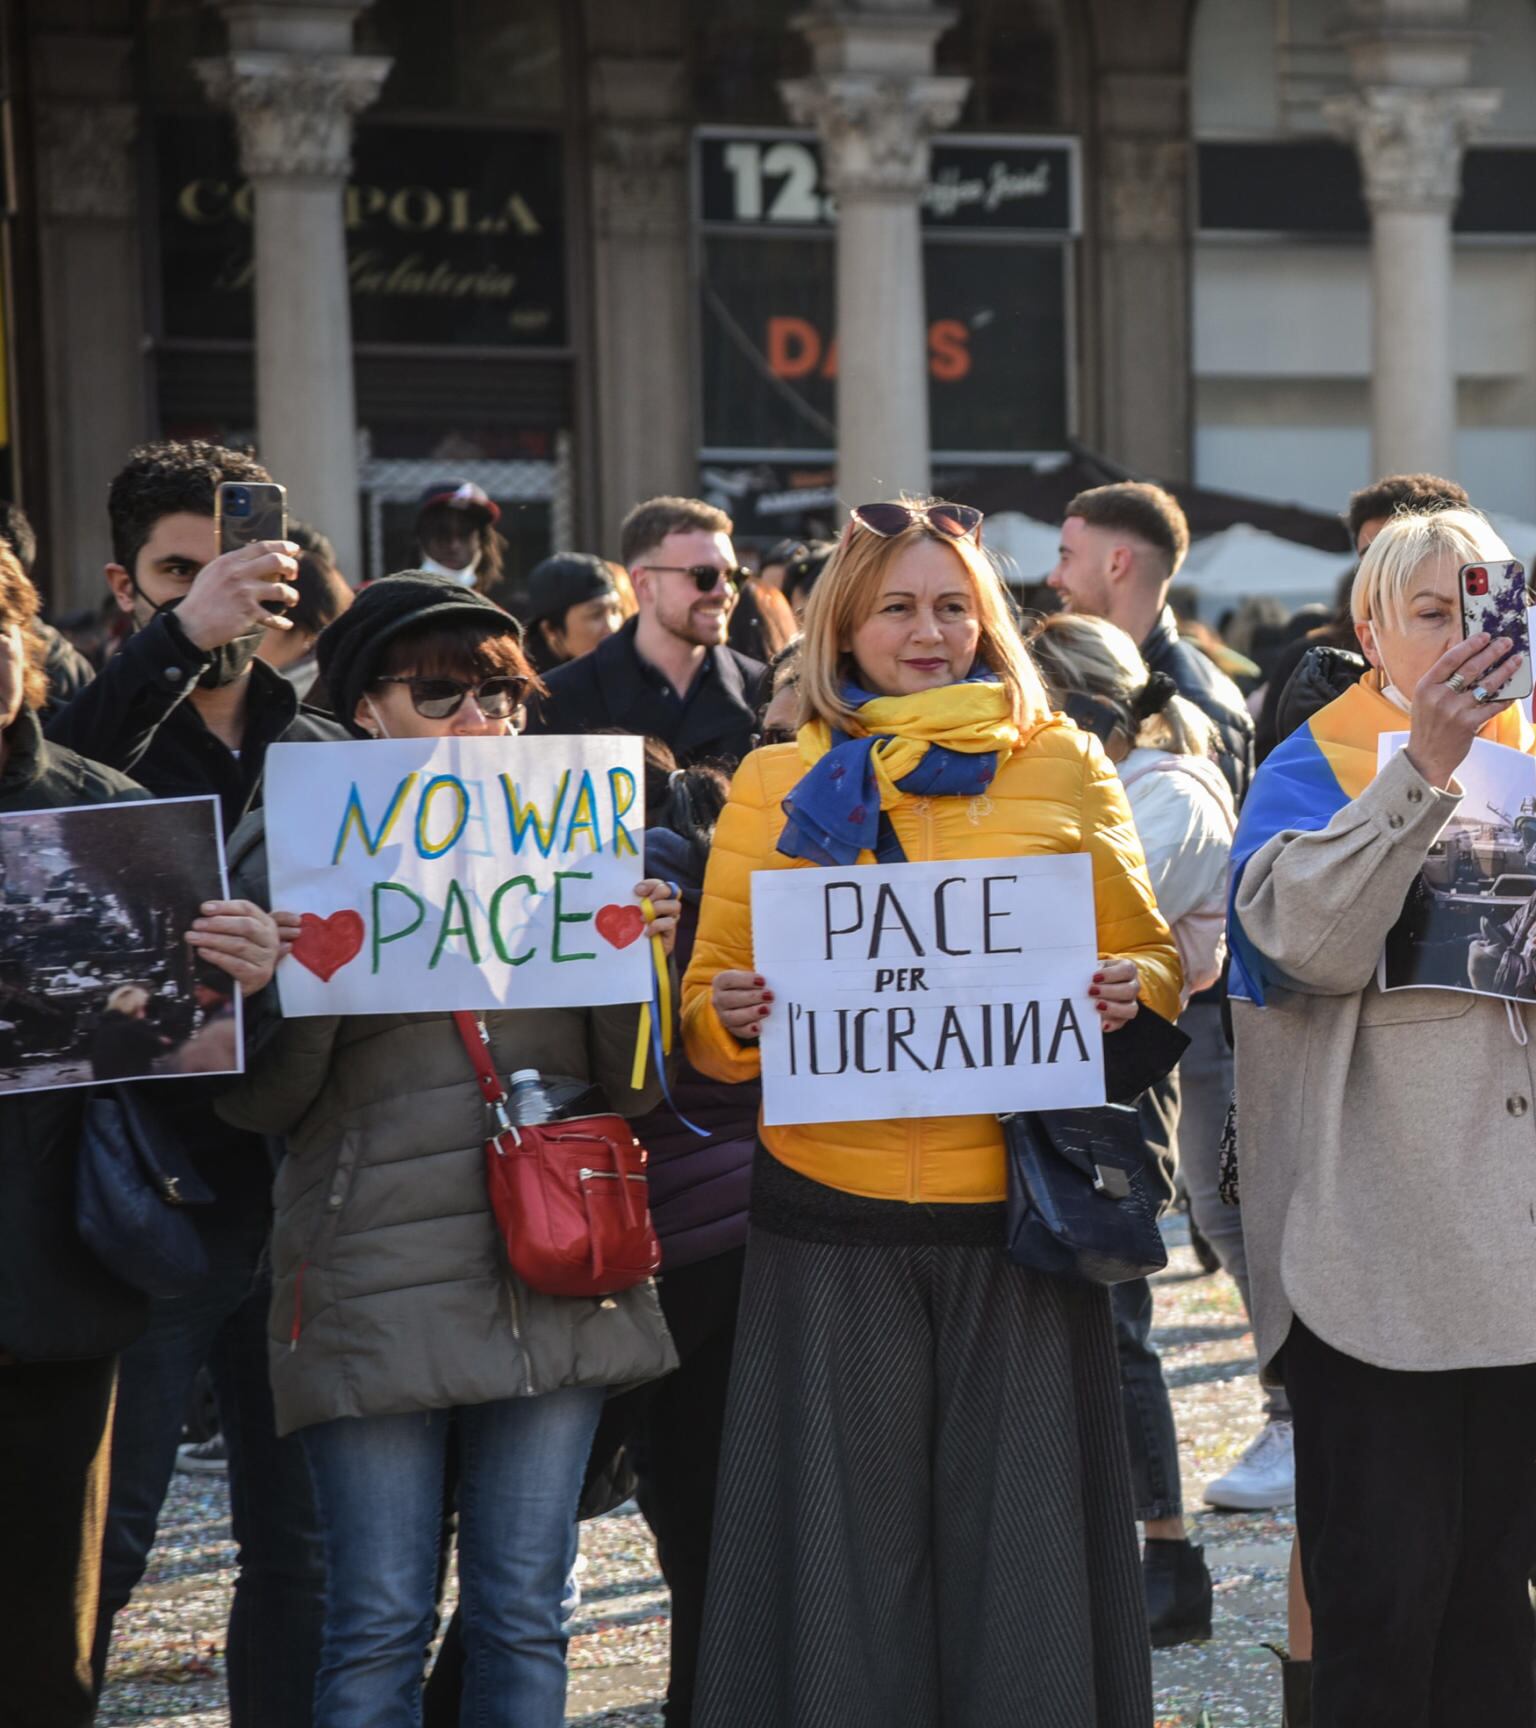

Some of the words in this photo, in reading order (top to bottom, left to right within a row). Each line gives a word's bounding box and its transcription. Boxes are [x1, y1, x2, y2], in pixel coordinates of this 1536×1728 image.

[178, 178, 542, 236] CPOLA
[332, 772, 470, 866] NO
[499, 767, 639, 859] WAR
[371, 871, 597, 975] PACE
[824, 875, 1023, 960] PACE
[874, 967, 929, 992] PER
